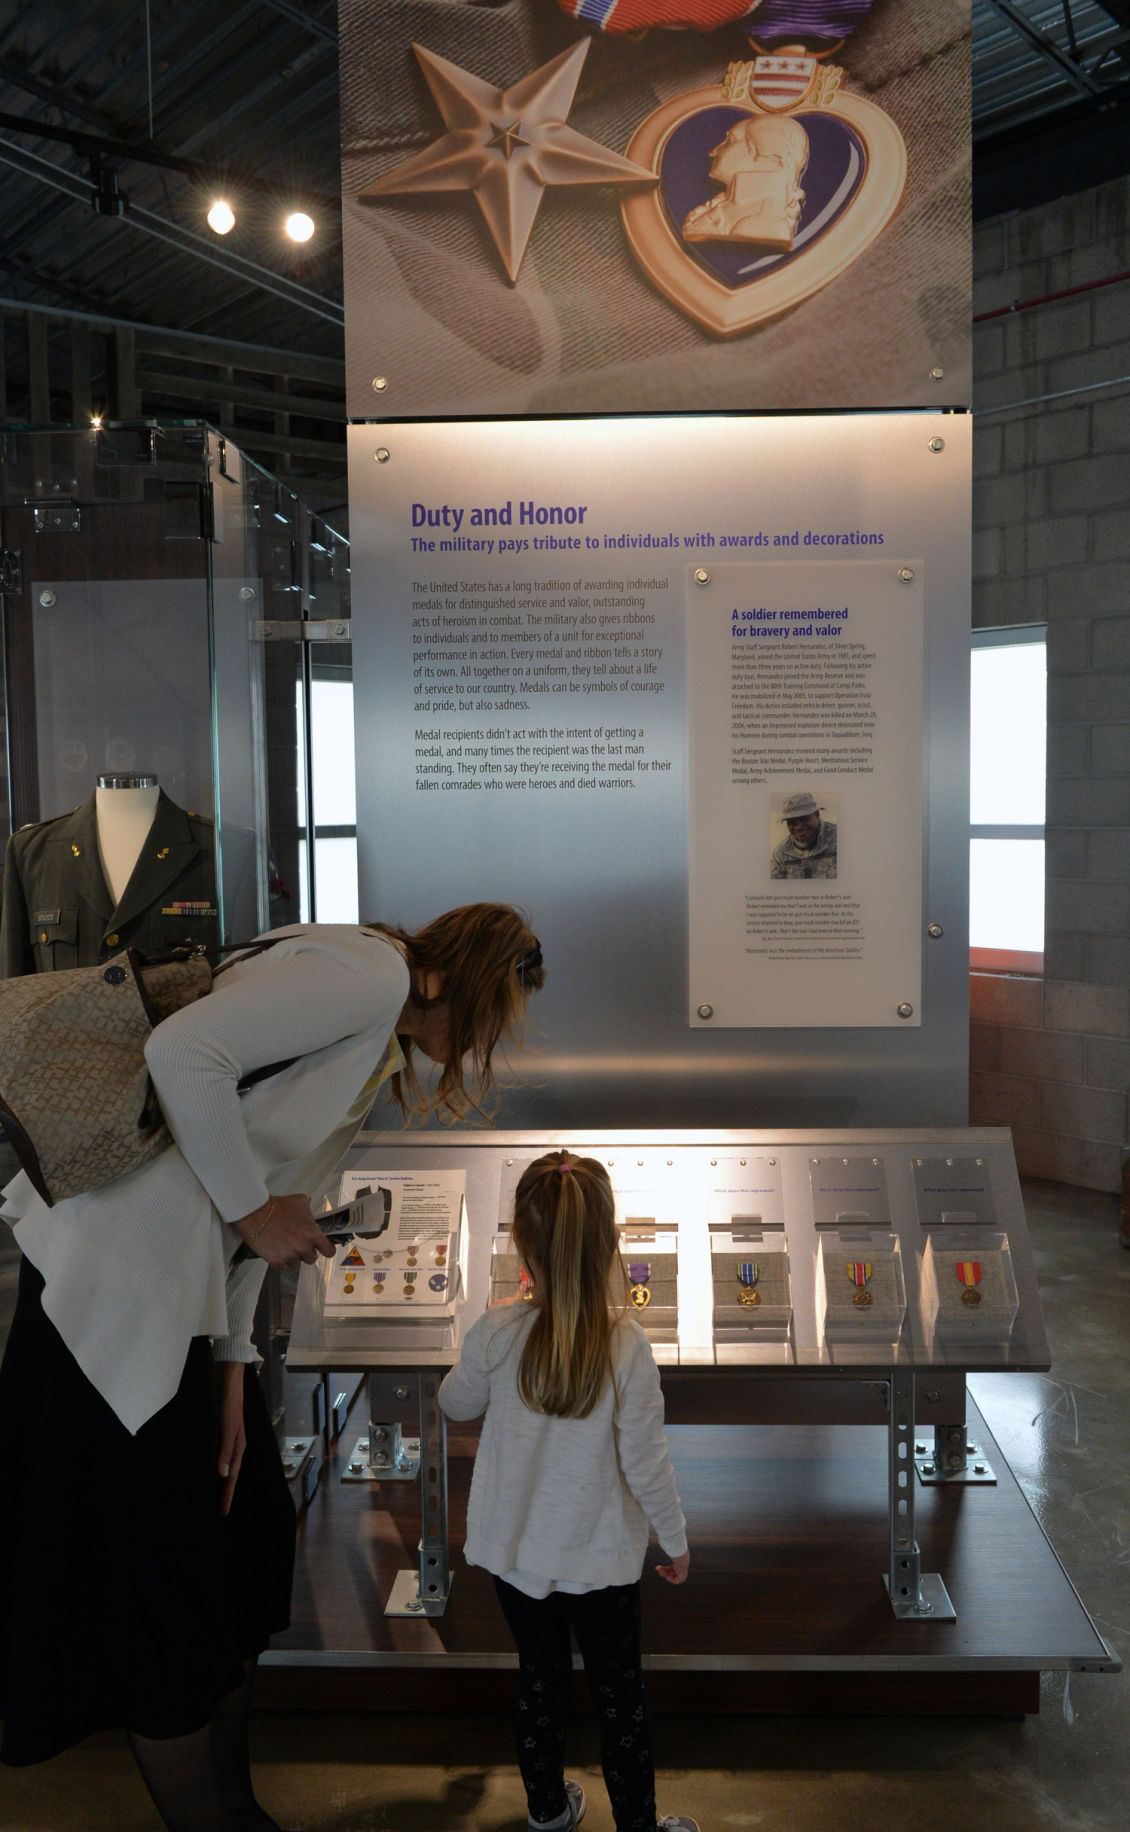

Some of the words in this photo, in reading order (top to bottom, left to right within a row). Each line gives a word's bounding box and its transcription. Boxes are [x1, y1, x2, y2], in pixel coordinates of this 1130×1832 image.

[412, 502, 464, 533] Duty
[470, 502, 512, 526] and
[519, 500, 587, 525] Honor
[411, 537, 435, 552] The
[440, 536, 494, 556] military
[498, 539, 528, 555] pays
[533, 534, 581, 550] tribute
[585, 536, 599, 550] to
[603, 533, 679, 549] individuals
[683, 532, 715, 548] with
[719, 531, 769, 547] awards
[773, 531, 799, 546] and
[803, 530, 883, 546] decorations
[413, 582, 427, 593] The
[429, 581, 458, 593] United
[460, 581, 486, 592] States
[488, 580, 503, 592] has
[504, 583, 510, 592] a
[512, 580, 531, 594] long
[533, 580, 570, 591] tradition
[572, 579, 581, 590] of
[583, 579, 624, 593] awarding
[626, 578, 668, 590] individual
[412, 598, 442, 610] medals
[445, 598, 457, 609] for
[458, 597, 515, 612] distinguished
[517, 597, 547, 608] service
[549, 597, 565, 608] and
[567, 596, 591, 608] valor,
[593, 596, 644, 610] outstanding
[412, 616, 430, 627] acts
[431, 615, 440, 626] of
[442, 615, 476, 626] heroism
[479, 615, 487, 626] in
[489, 614, 524, 626] combat.
[527, 614, 542, 625] The
[544, 613, 577, 627] military
[579, 613, 596, 624] also
[598, 613, 620, 627] gives
[623, 612, 655, 624] ribbons
[731, 609, 738, 620] A
[741, 608, 777, 620] soldier
[779, 607, 848, 620] remembered
[412, 633, 421, 643] to
[423, 632, 469, 643] individuals
[471, 631, 487, 642] and
[489, 632, 498, 642] to
[500, 631, 541, 642] members
[543, 630, 552, 642] of
[554, 633, 559, 641] a
[562, 630, 579, 641] unit
[581, 630, 593, 641] for
[595, 629, 644, 643] exceptional
[731, 625, 747, 636] for
[749, 624, 790, 639] bravery
[792, 624, 812, 636] and
[815, 624, 842, 636] valor
[413, 649, 467, 663] performance
[469, 648, 477, 660] in
[479, 648, 509, 660] action.
[510, 648, 534, 662] Every
[536, 647, 562, 659] medal
[564, 647, 581, 658] and
[583, 647, 611, 658] ribbon
[614, 646, 631, 658] tells
[633, 649, 638, 658] a
[640, 647, 662, 660] story
[413, 666, 422, 677] of
[424, 666, 434, 677] its
[436, 668, 458, 677] own.
[460, 665, 471, 676] All
[473, 665, 510, 679] together
[512, 667, 523, 676] on
[525, 667, 530, 676] a
[533, 664, 570, 676] uniform,
[572, 664, 591, 678] they
[593, 664, 606, 675] tell
[608, 663, 634, 675] about
[636, 666, 641, 674] a
[644, 663, 657, 674] life
[413, 683, 422, 694] of
[424, 683, 453, 694] service
[454, 684, 464, 694] to
[466, 685, 481, 694] our
[482, 683, 518, 696] country.
[519, 682, 549, 693] Medals
[552, 684, 567, 693] can
[569, 681, 580, 692] be
[582, 681, 617, 695] symbols
[619, 681, 628, 692] of
[630, 683, 664, 694] courage
[414, 700, 430, 711] and
[432, 699, 457, 713] pride,
[458, 699, 474, 710] but
[475, 699, 492, 710] also
[494, 698, 530, 710] sadness.
[414, 729, 440, 740] Medal
[443, 728, 484, 742] recipients
[486, 728, 510, 739] didn't
[512, 729, 526, 739] act
[527, 728, 547, 739] with
[549, 728, 564, 739] the
[566, 728, 592, 739] intent
[593, 727, 602, 738] of
[604, 727, 636, 741] getting
[638, 730, 643, 738] a
[415, 746, 444, 758] medal,
[446, 745, 462, 757] and
[464, 748, 488, 759] many
[490, 745, 514, 756] times
[516, 745, 530, 756] the
[532, 744, 569, 758] recipient
[571, 746, 588, 755] was
[591, 744, 605, 755] the
[607, 744, 622, 755] last
[624, 746, 644, 755] man
[415, 762, 455, 776] standing.
[458, 762, 477, 776] They
[479, 762, 501, 773] often
[503, 764, 518, 775] say
[520, 761, 549, 775] they're
[551, 761, 589, 775] receiving
[591, 761, 606, 772] the
[608, 761, 634, 772] medal
[637, 760, 649, 772] for
[651, 760, 671, 771] their
[415, 779, 439, 790] fallen
[441, 779, 481, 790] comrades
[483, 778, 503, 790] who
[505, 781, 526, 789] were
[528, 778, 557, 789] heroes
[558, 778, 575, 789] and
[577, 777, 596, 789] died
[598, 777, 636, 788] warriors.
